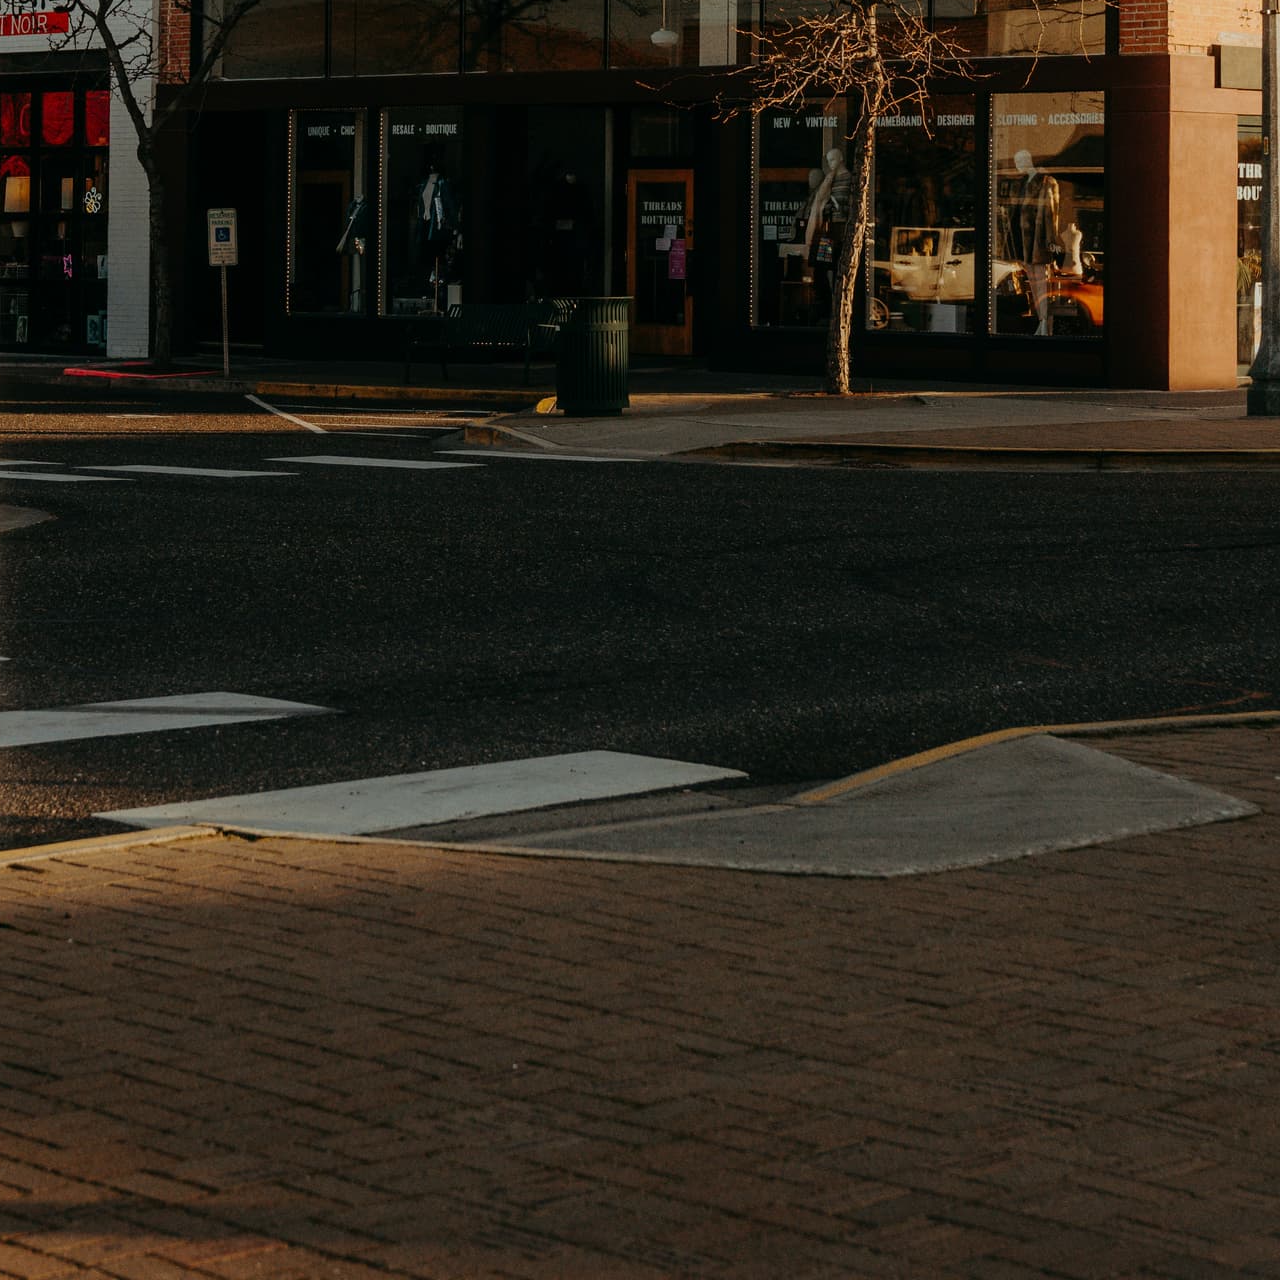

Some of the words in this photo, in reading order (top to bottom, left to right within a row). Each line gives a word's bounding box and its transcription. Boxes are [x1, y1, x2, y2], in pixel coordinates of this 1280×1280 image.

[11, 14, 48, 35] NOIR
[773, 117, 791, 129] NEW
[805, 116, 838, 128] VINTAGE
[875, 114, 922, 128] NAMEBRAND
[937, 113, 976, 126] DESIGNER
[997, 113, 1038, 126] CLOTHING
[1048, 112, 1104, 125] ACCESSORIES
[307, 125, 331, 137] UNIQUE
[340, 125, 356, 136] CHIC
[392, 123, 415, 136] RESALE
[425, 123, 457, 136] BOUTIQUE
[643, 201, 683, 212] THREADS
[641, 215, 684, 225] BOUTIQUE
